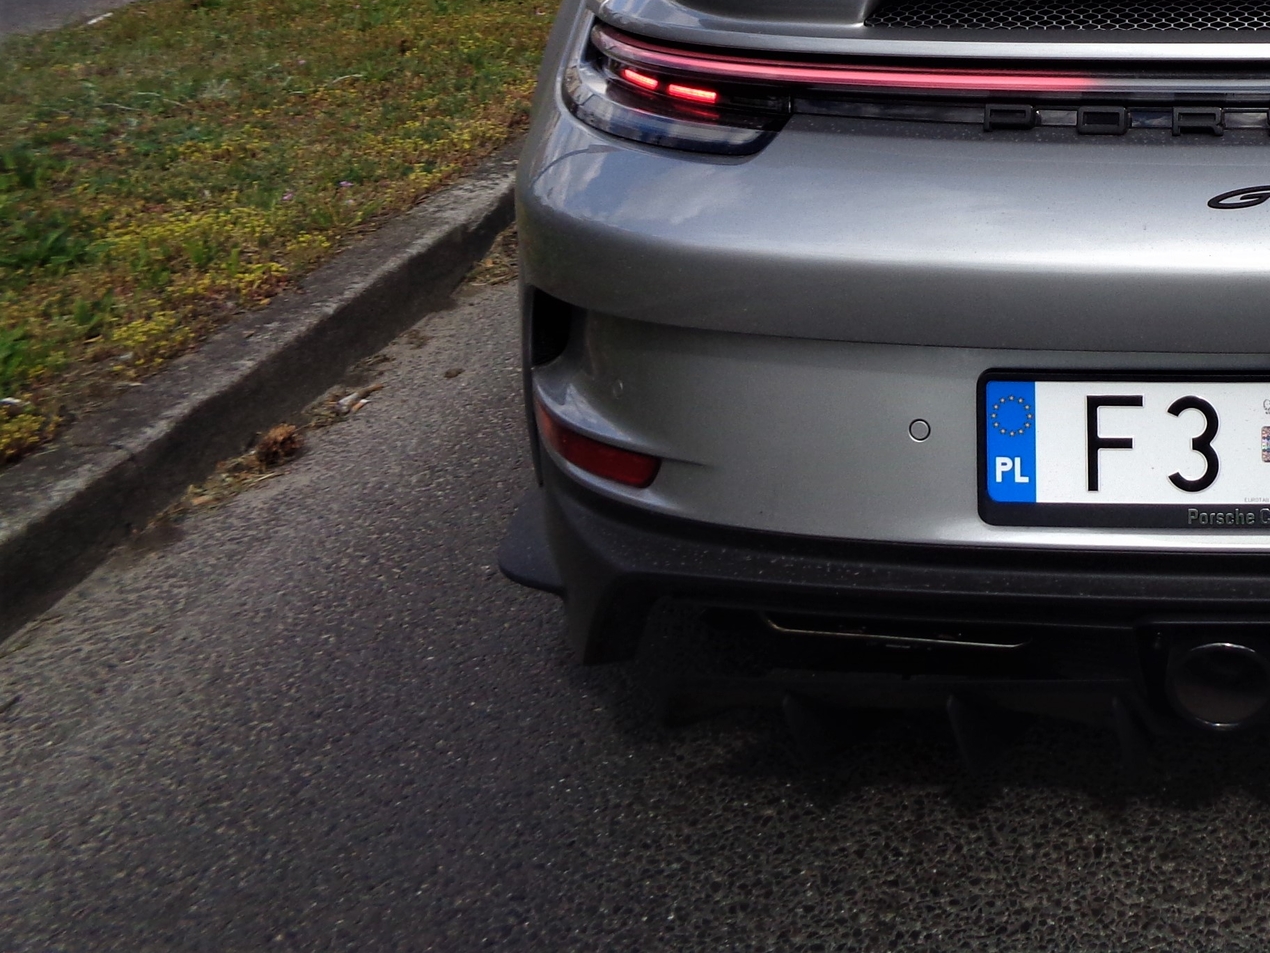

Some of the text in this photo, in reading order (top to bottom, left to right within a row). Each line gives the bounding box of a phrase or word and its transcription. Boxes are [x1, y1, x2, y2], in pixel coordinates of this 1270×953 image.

[1086, 394, 1220, 493] F3
[995, 456, 1030, 484] PL
[1187, 507, 1255, 526] Porsche
